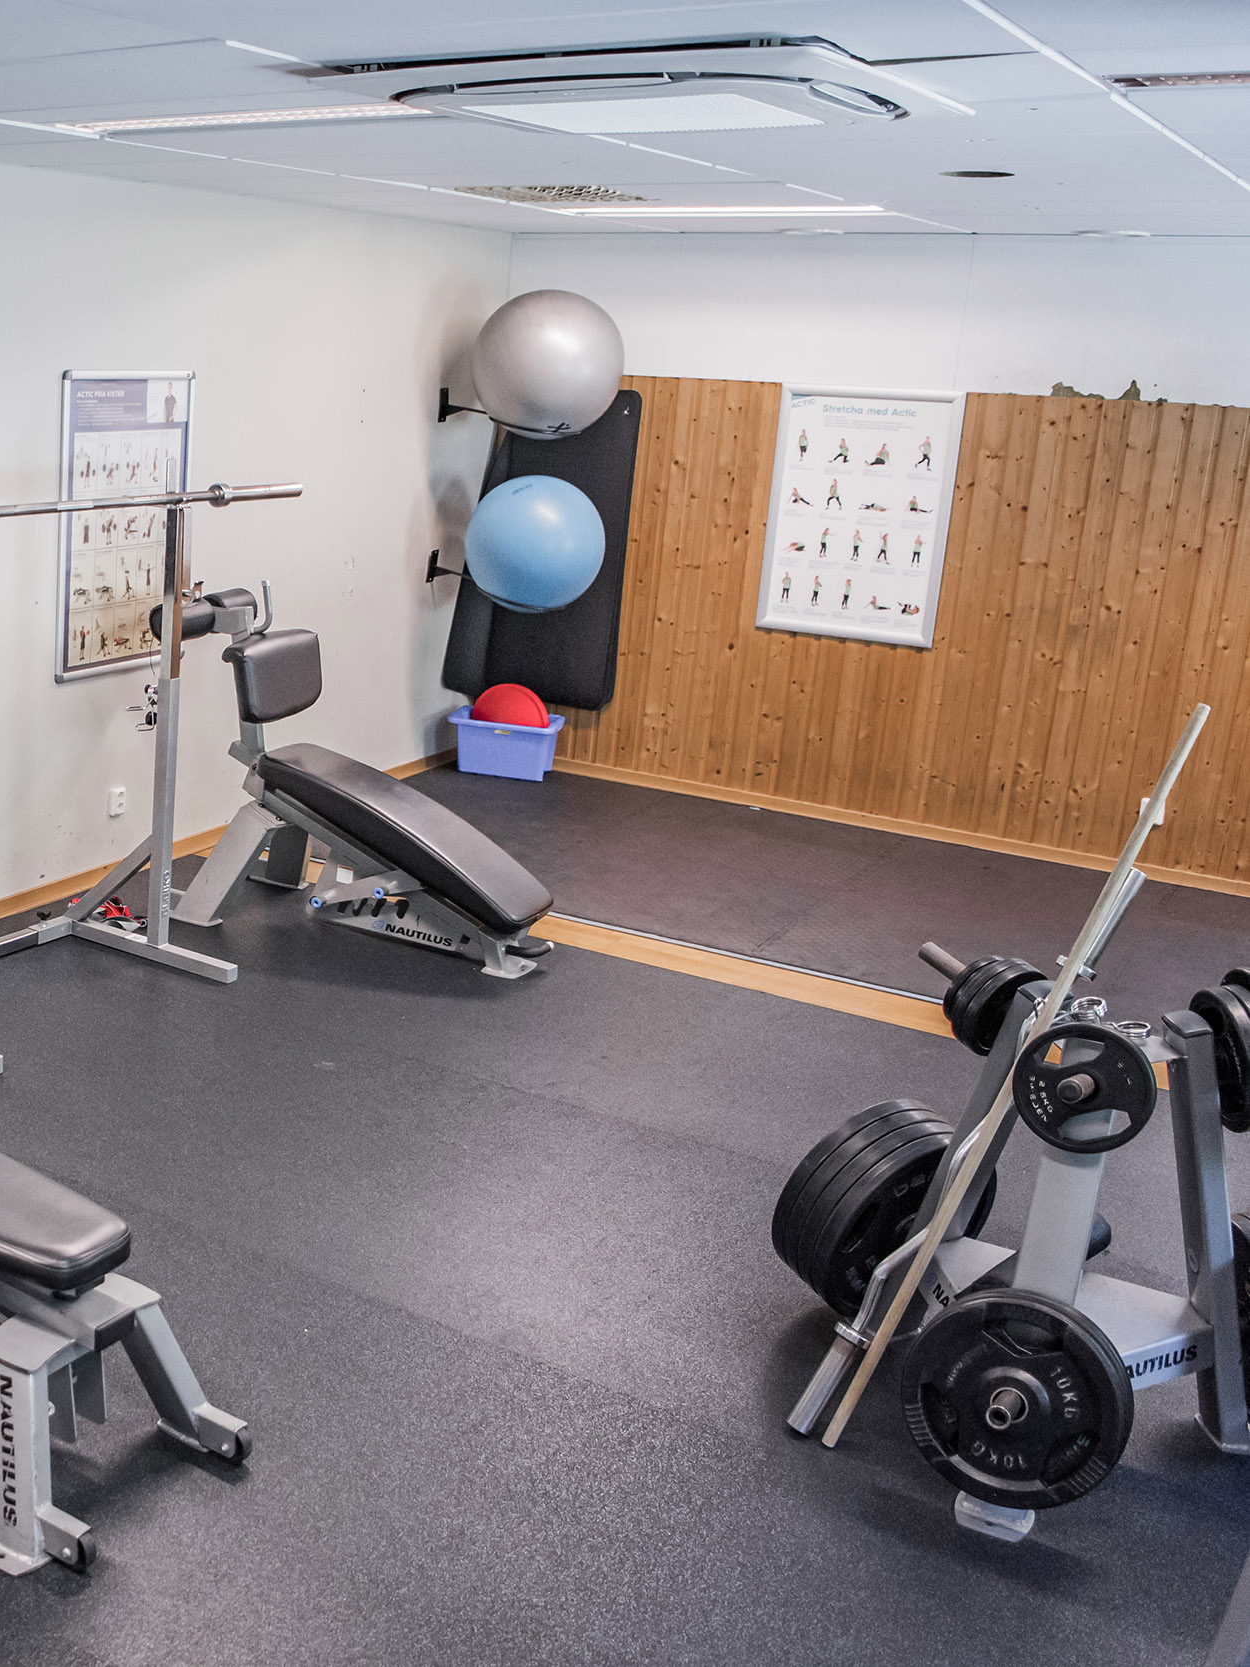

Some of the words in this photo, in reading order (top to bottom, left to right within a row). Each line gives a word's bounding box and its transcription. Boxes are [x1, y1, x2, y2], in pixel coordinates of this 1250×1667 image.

[791, 397, 816, 408] ACTIC
[823, 404, 863, 415] Stretcha
[867, 405, 888, 416] med
[891, 408, 917, 418] Actic
[384, 923, 453, 947] NAUTILUS
[1124, 1344, 1198, 1380] AUTILUS
[0, 1374, 17, 1527] NAUTILUS
